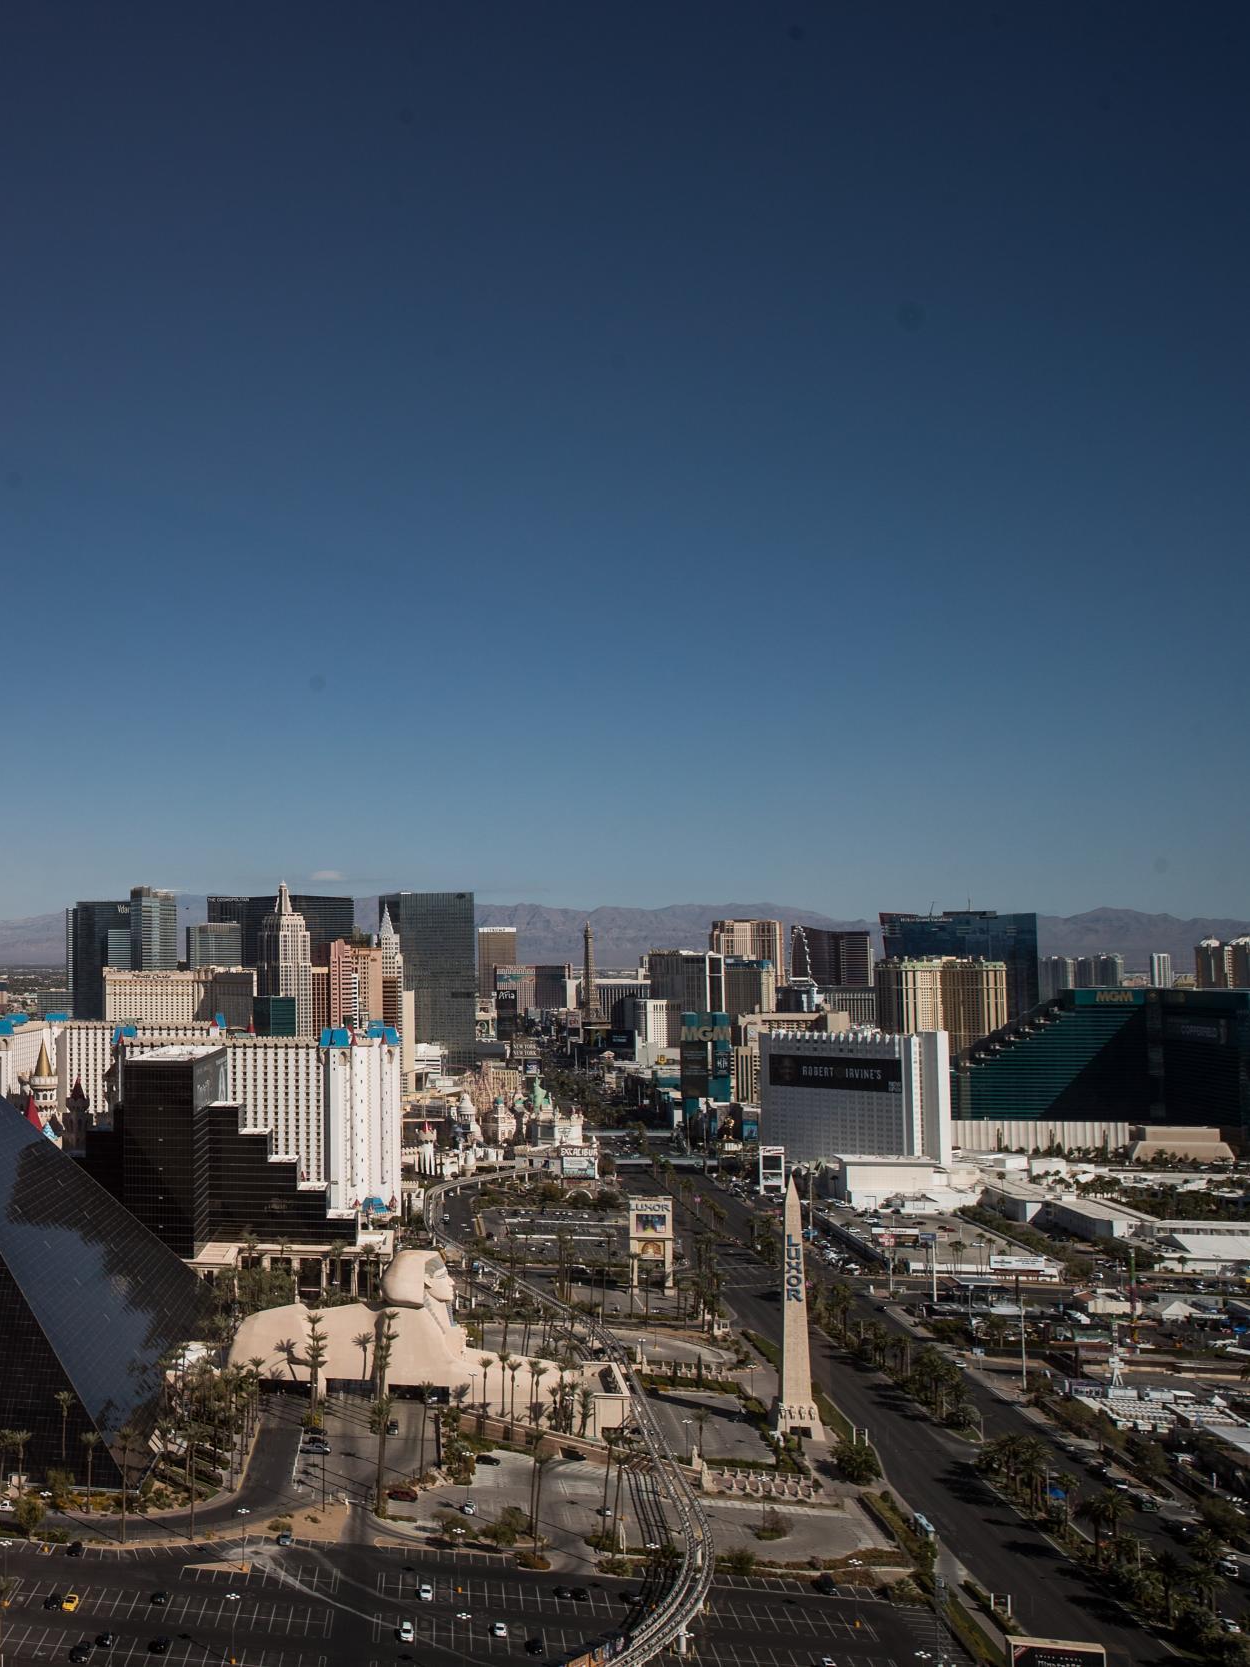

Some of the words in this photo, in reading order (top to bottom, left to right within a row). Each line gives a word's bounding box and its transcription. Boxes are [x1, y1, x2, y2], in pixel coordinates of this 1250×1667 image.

[1095, 991, 1134, 1002] MGM
[680, 1026, 731, 1042] MGM
[802, 1065, 834, 1078] ROBERT
[845, 1067, 882, 1080] IRVINE'S
[560, 1147, 598, 1156] EXCALIBUR
[629, 1203, 671, 1212] LUXOR
[785, 1233, 803, 1303] LUXOR
